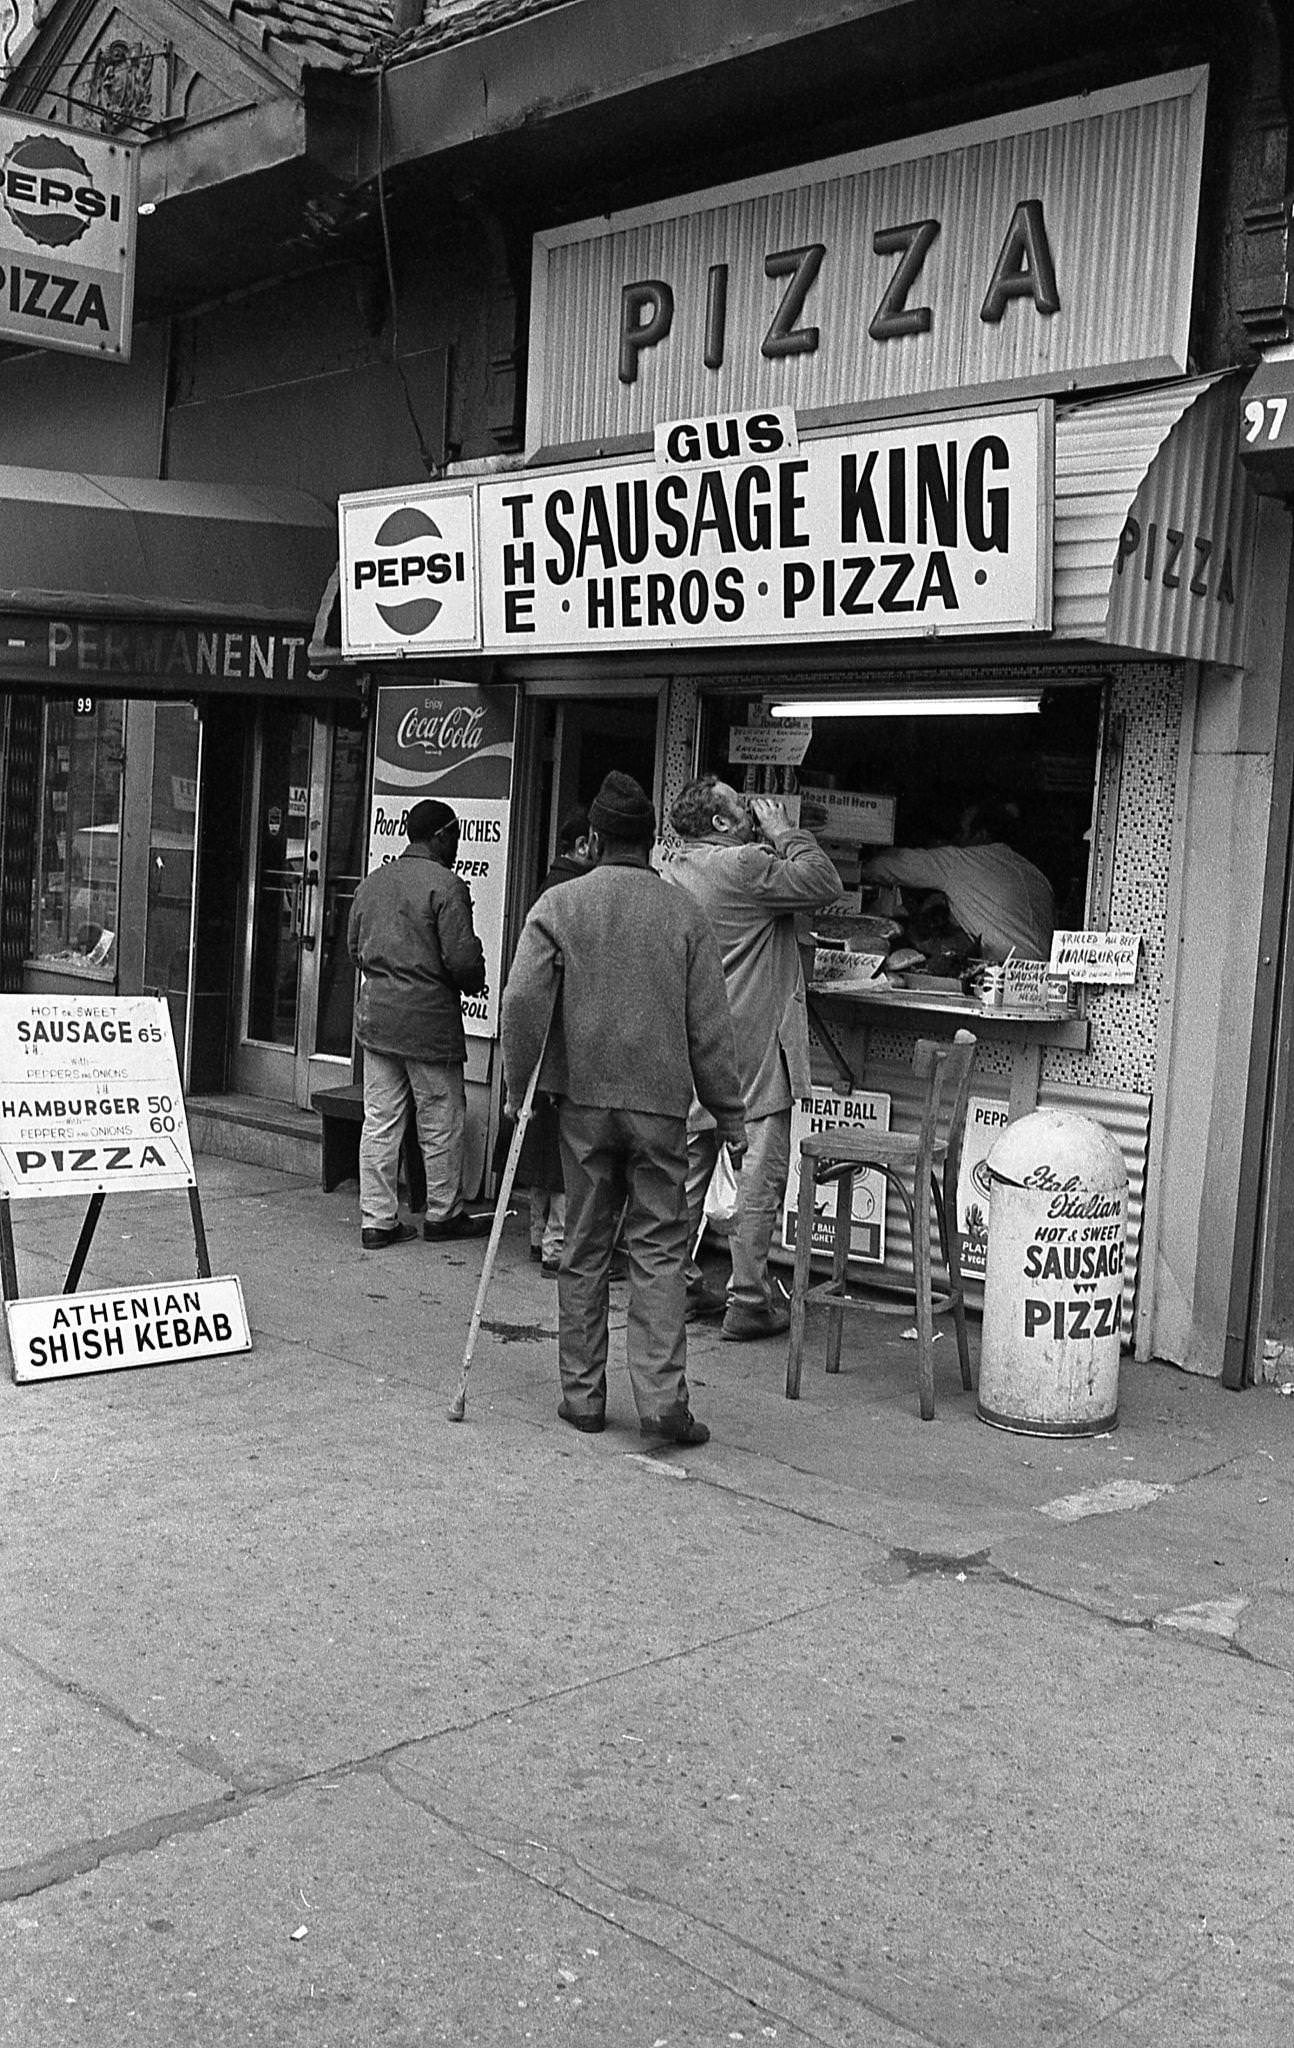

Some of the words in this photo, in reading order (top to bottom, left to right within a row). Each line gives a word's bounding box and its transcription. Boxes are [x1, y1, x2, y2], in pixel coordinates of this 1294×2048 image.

[0, 169, 120, 222] EPSI
[0, 265, 110, 331] IZZA
[618, 199, 1061, 384] PIZZA
[667, 413, 785, 465] GUS
[1244, 398, 1288, 443] 97
[544, 459, 810, 586] SAUSAGE
[840, 434, 1010, 554] KING
[354, 551, 465, 590] PEPSI
[502, 494, 535, 634] THE
[1116, 516, 1235, 605] PIZZA
[587, 567, 745, 629] HEROS
[783, 550, 960, 619] PIZZA
[77, 697, 92, 712] 99
[424, 698, 443, 710] Enjoy
[31, 1006, 59, 1017] HOT
[76, 1006, 117, 1017] SWEET
[17, 1020, 133, 1044] SAUSAGE
[92, 1068, 129, 1079] ONIONS
[2, 1097, 140, 1118] HAMBURGER
[801, 1097, 841, 1116] MEAT
[844, 1101, 878, 1121] BALL
[20, 1127, 74, 1139] PEPPERS
[90, 1125, 133, 1137] ONIONS
[16, 1145, 166, 1174] PIZZA
[1047, 1193, 1122, 1220] Italian
[1034, 1226, 1069, 1242] HOT
[1068, 1229, 1078, 1242] &
[1081, 1224, 1121, 1242] SWEET
[1023, 1240, 1125, 1280] SAUSAGE
[52, 1291, 201, 1330] ATHENIAN
[28, 1325, 125, 1368] SHISH
[134, 1312, 233, 1353] KEBAB
